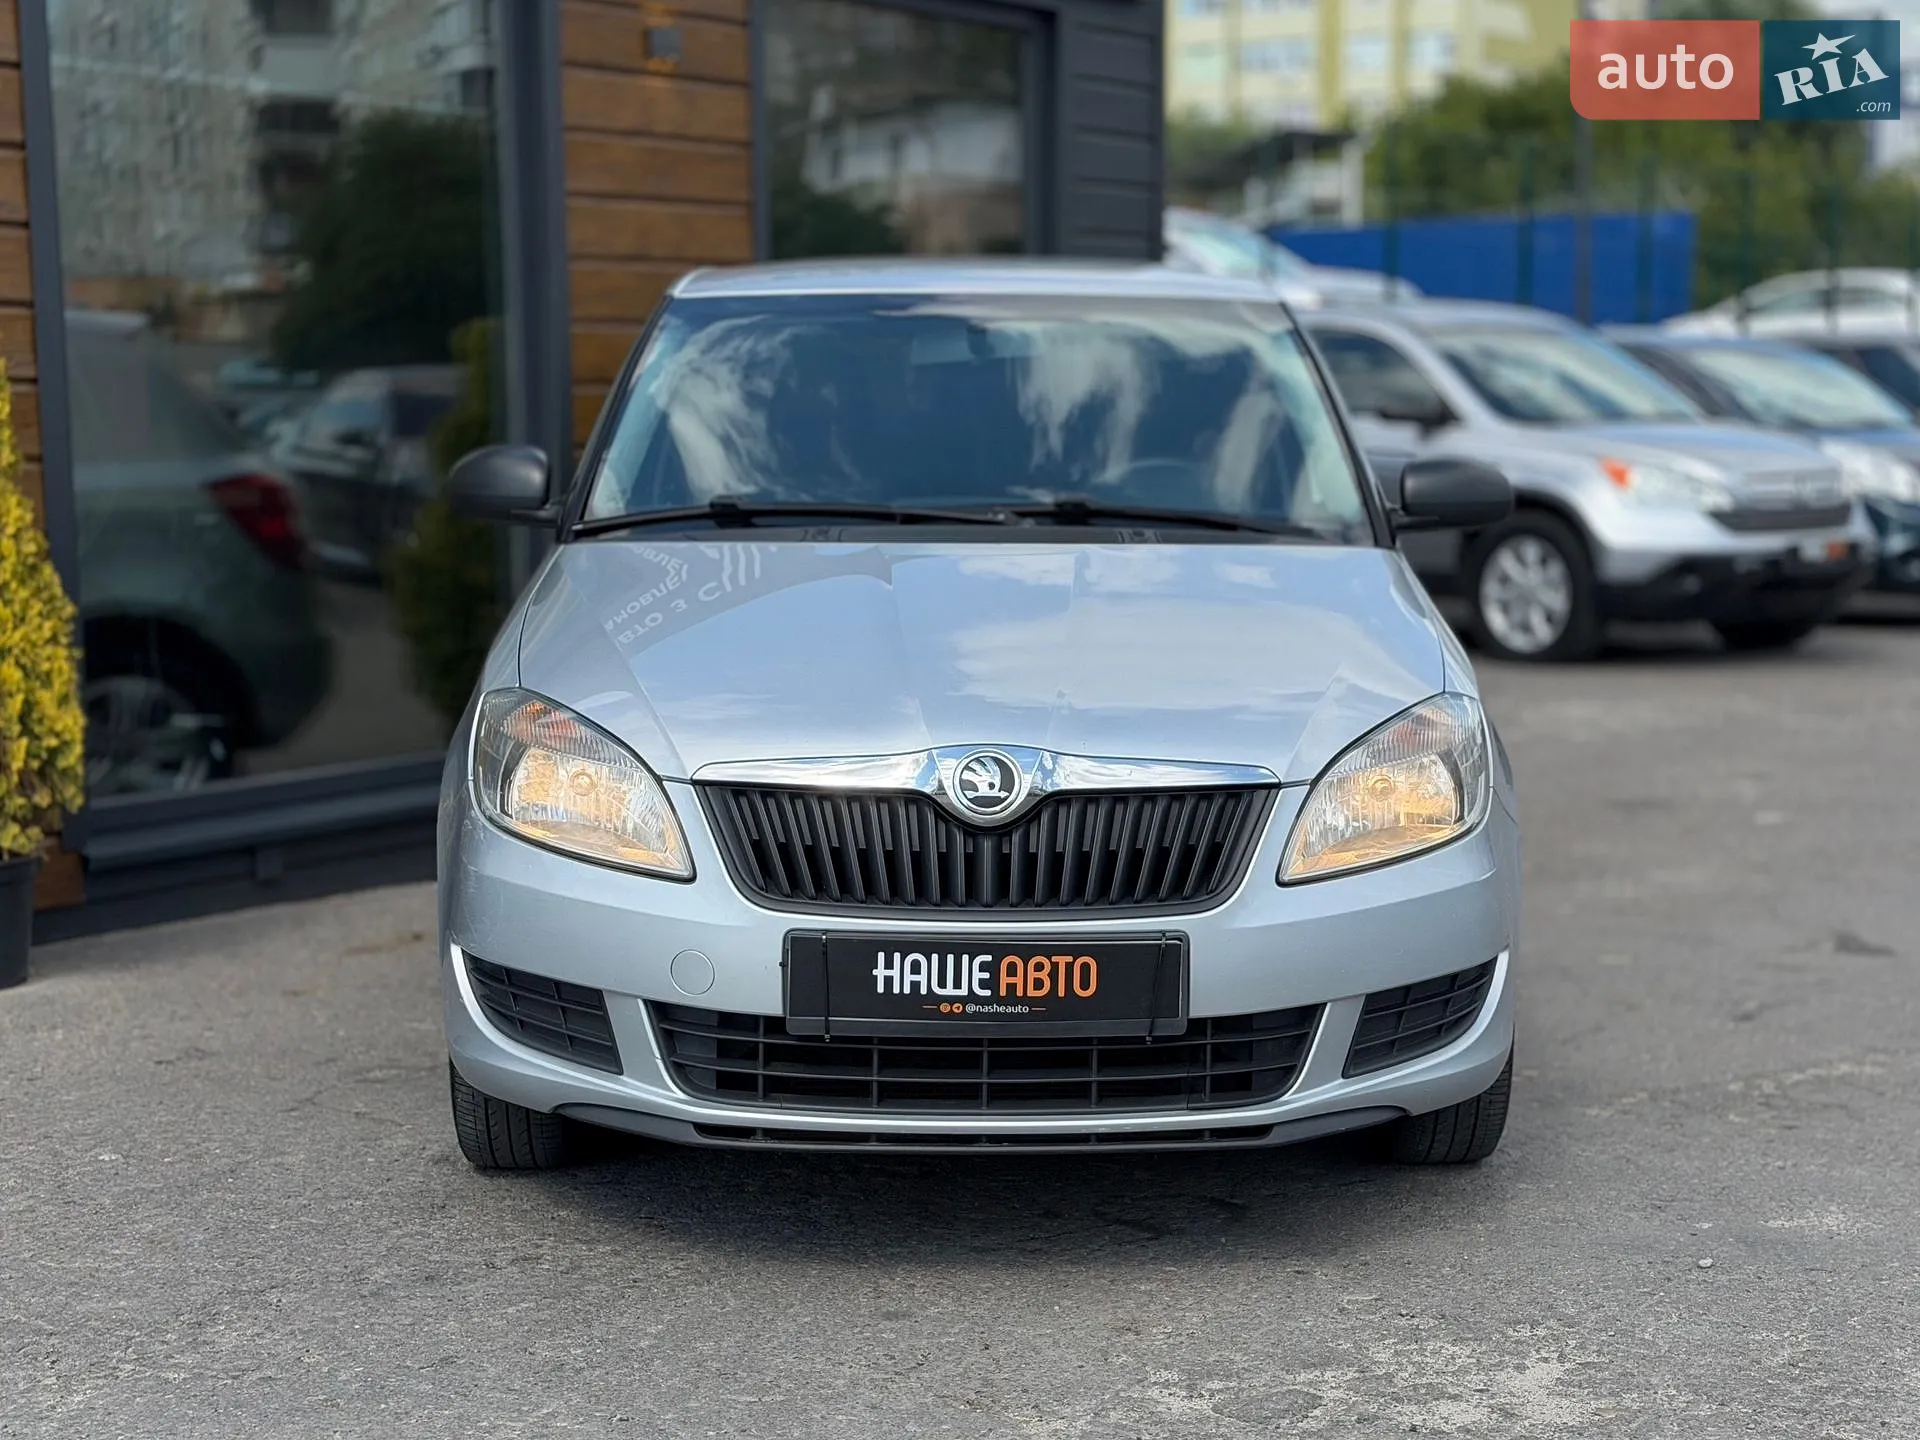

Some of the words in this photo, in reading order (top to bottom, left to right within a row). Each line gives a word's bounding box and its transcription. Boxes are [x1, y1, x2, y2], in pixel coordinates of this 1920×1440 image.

[872, 951, 993, 996] НАШЕ
[1000, 955, 1098, 998] АВТО
[965, 1003, 1029, 1014] @nasheauto
